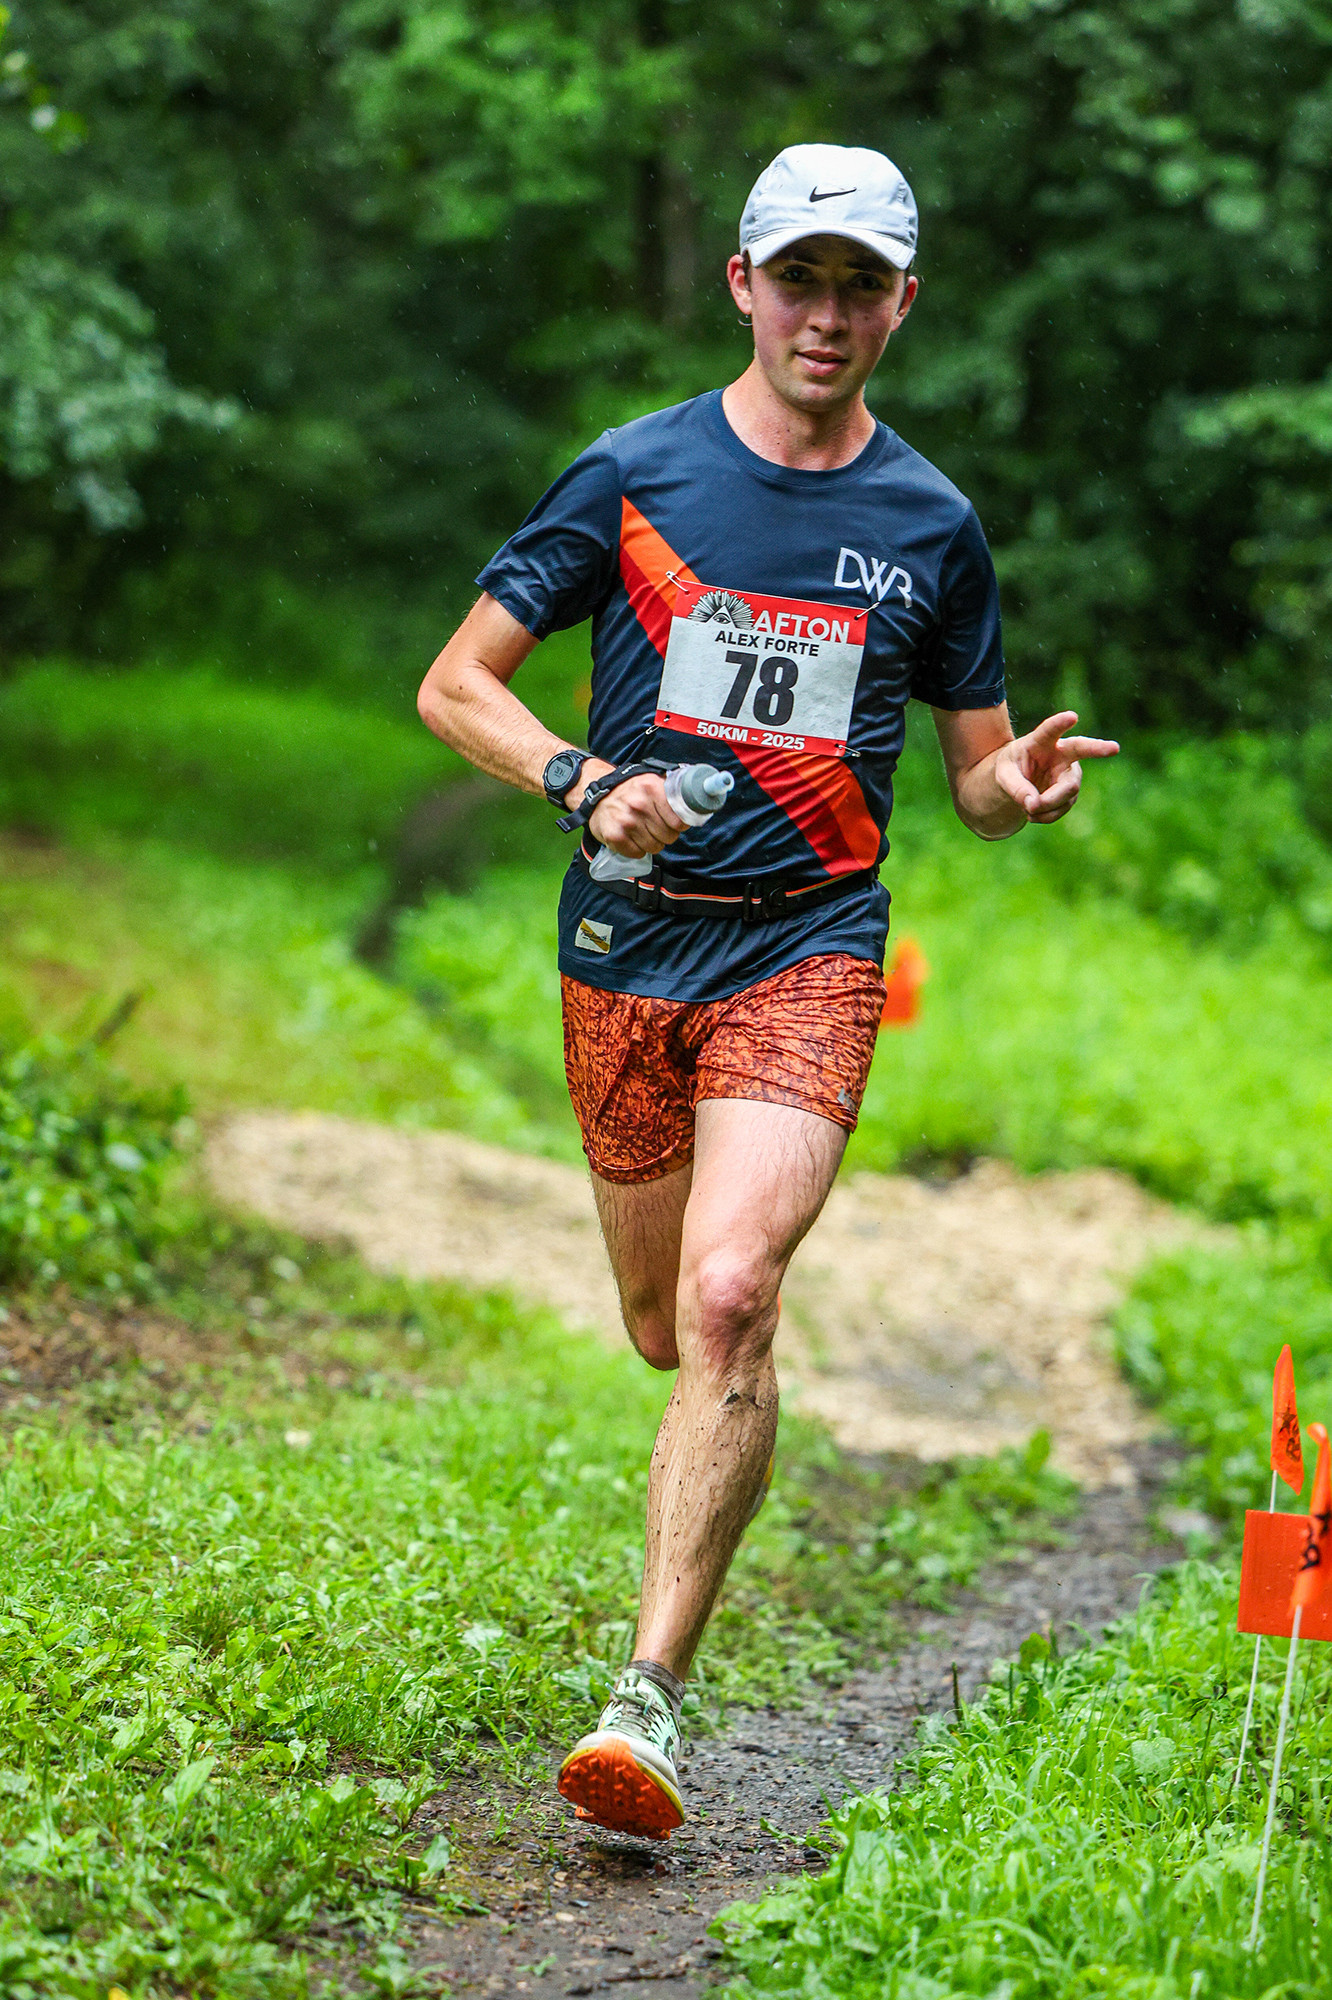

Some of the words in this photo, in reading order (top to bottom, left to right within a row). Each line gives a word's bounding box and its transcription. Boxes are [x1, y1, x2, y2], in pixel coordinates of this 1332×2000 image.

[834, 547, 913, 609] DWR
[752, 610, 850, 643] AFTON
[715, 630, 759, 648] ALEX
[764, 637, 820, 657] FORTE
[719, 650, 799, 727] 78
[696, 721, 750, 742] 50KM
[760, 732, 805, 750] 2025
